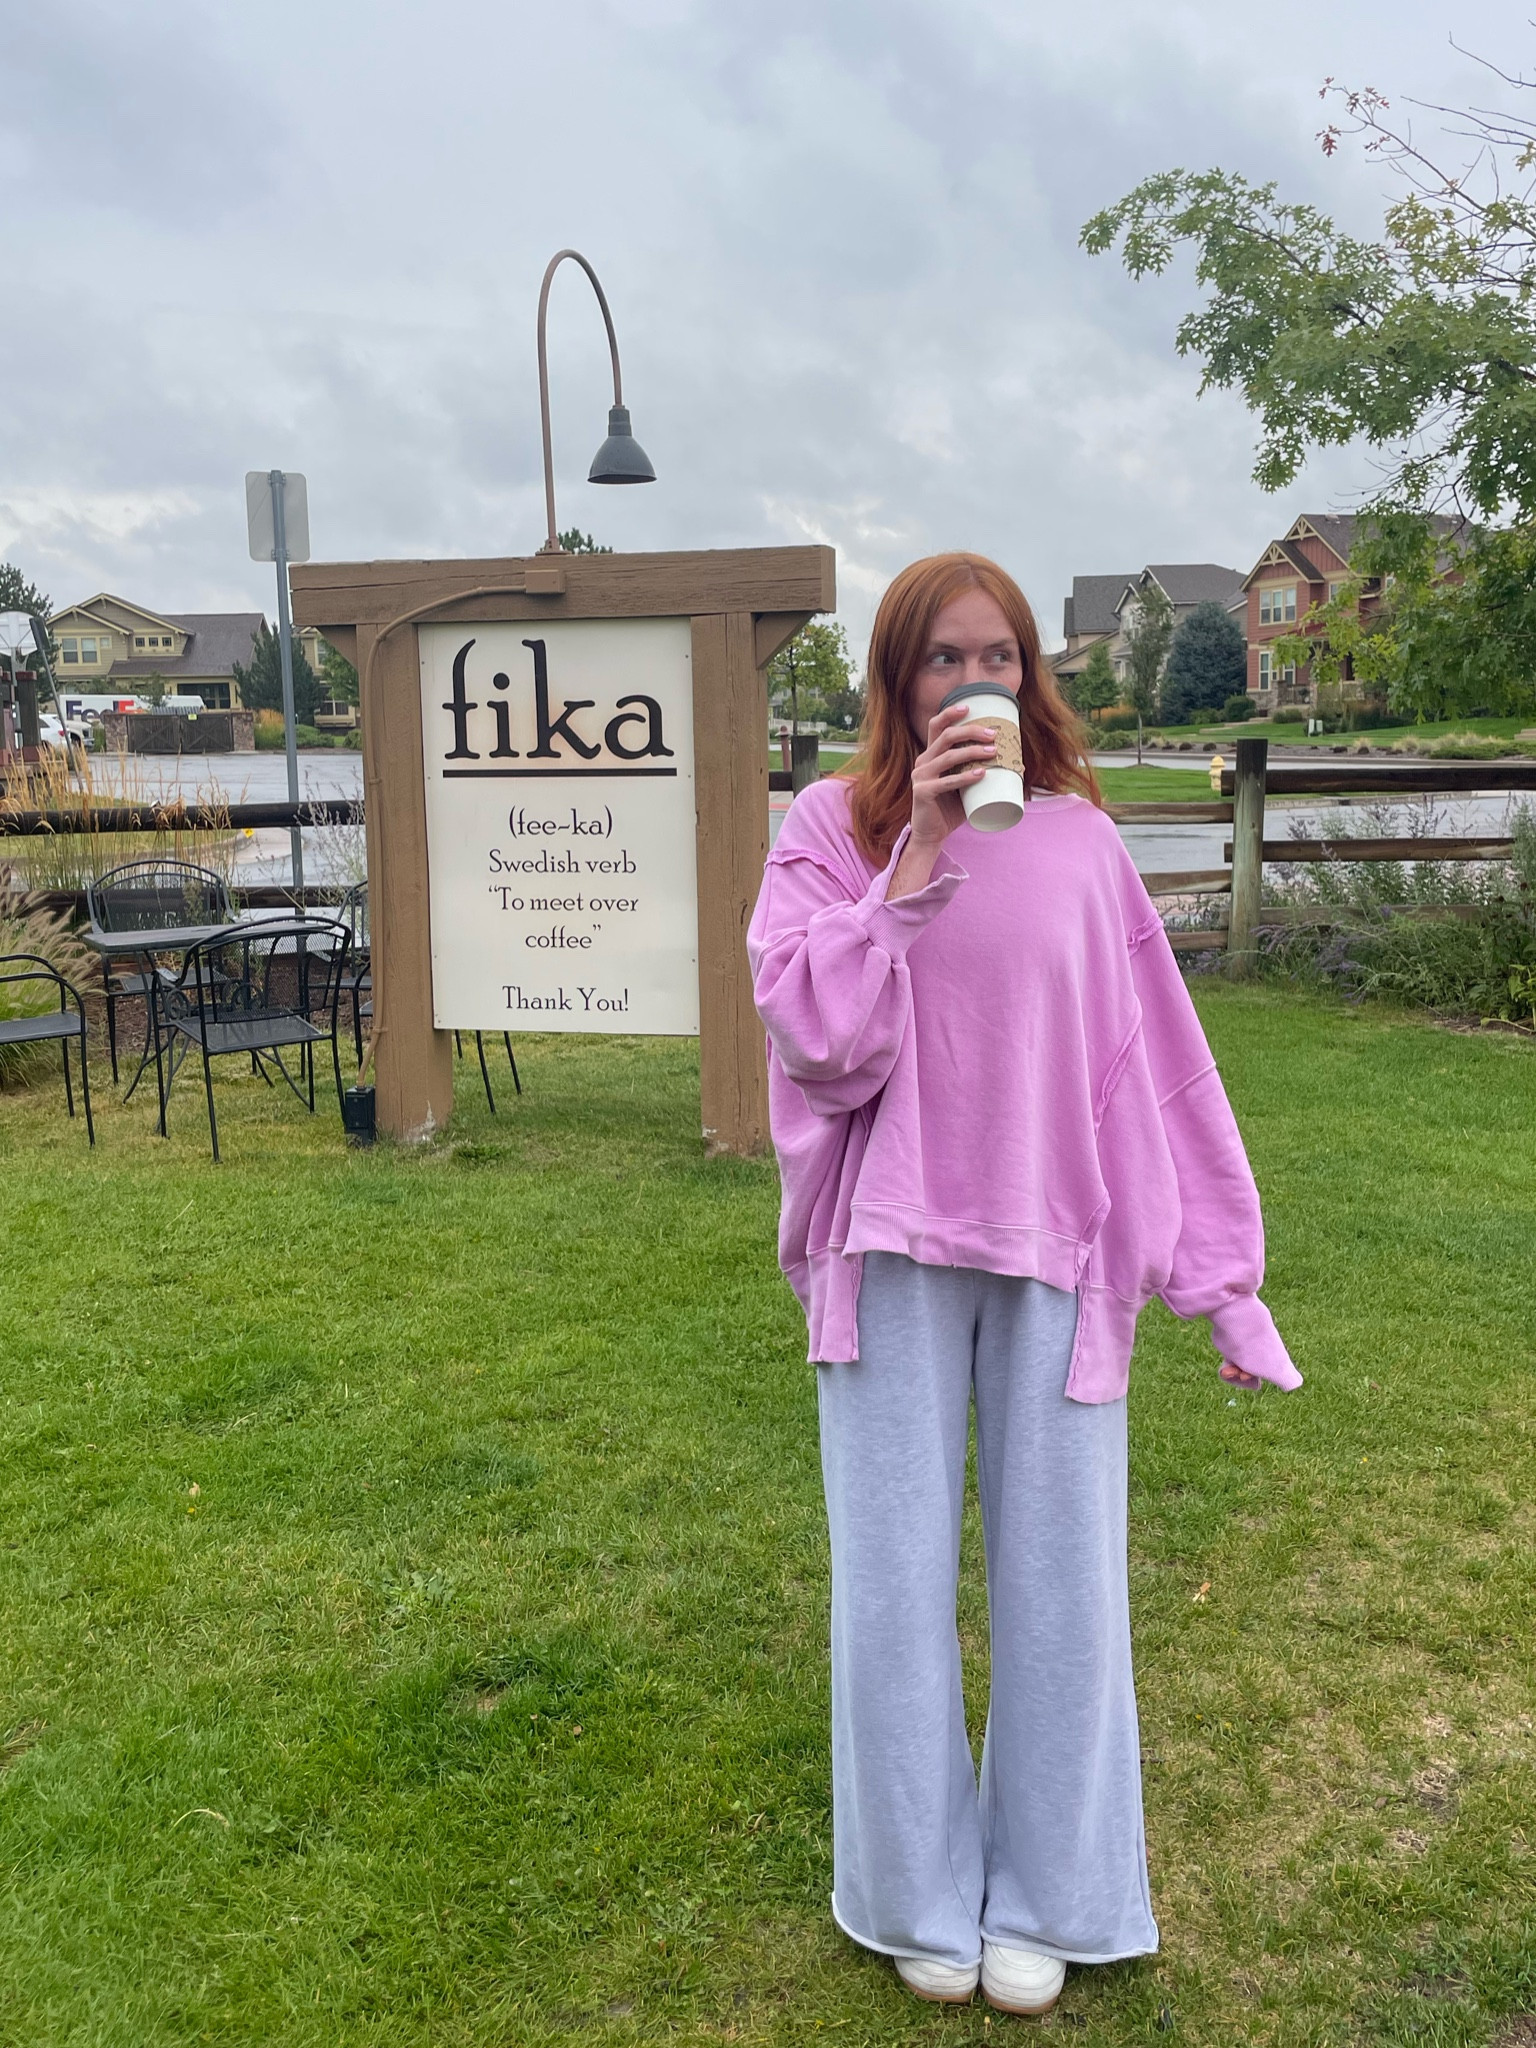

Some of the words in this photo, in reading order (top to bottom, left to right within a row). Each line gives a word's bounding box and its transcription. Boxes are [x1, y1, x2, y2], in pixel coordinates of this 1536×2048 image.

[442, 638, 674, 761] fika
[509, 805, 613, 839] (fee-ka)
[489, 849, 581, 874] Swedish
[585, 849, 637, 874] verb
[488, 886, 525, 911] “To
[529, 892, 584, 912] meet
[589, 898, 639, 912] over
[525, 924, 602, 949] coffee”
[502, 986, 573, 1011] Thank
[576, 987, 629, 1012] You!
